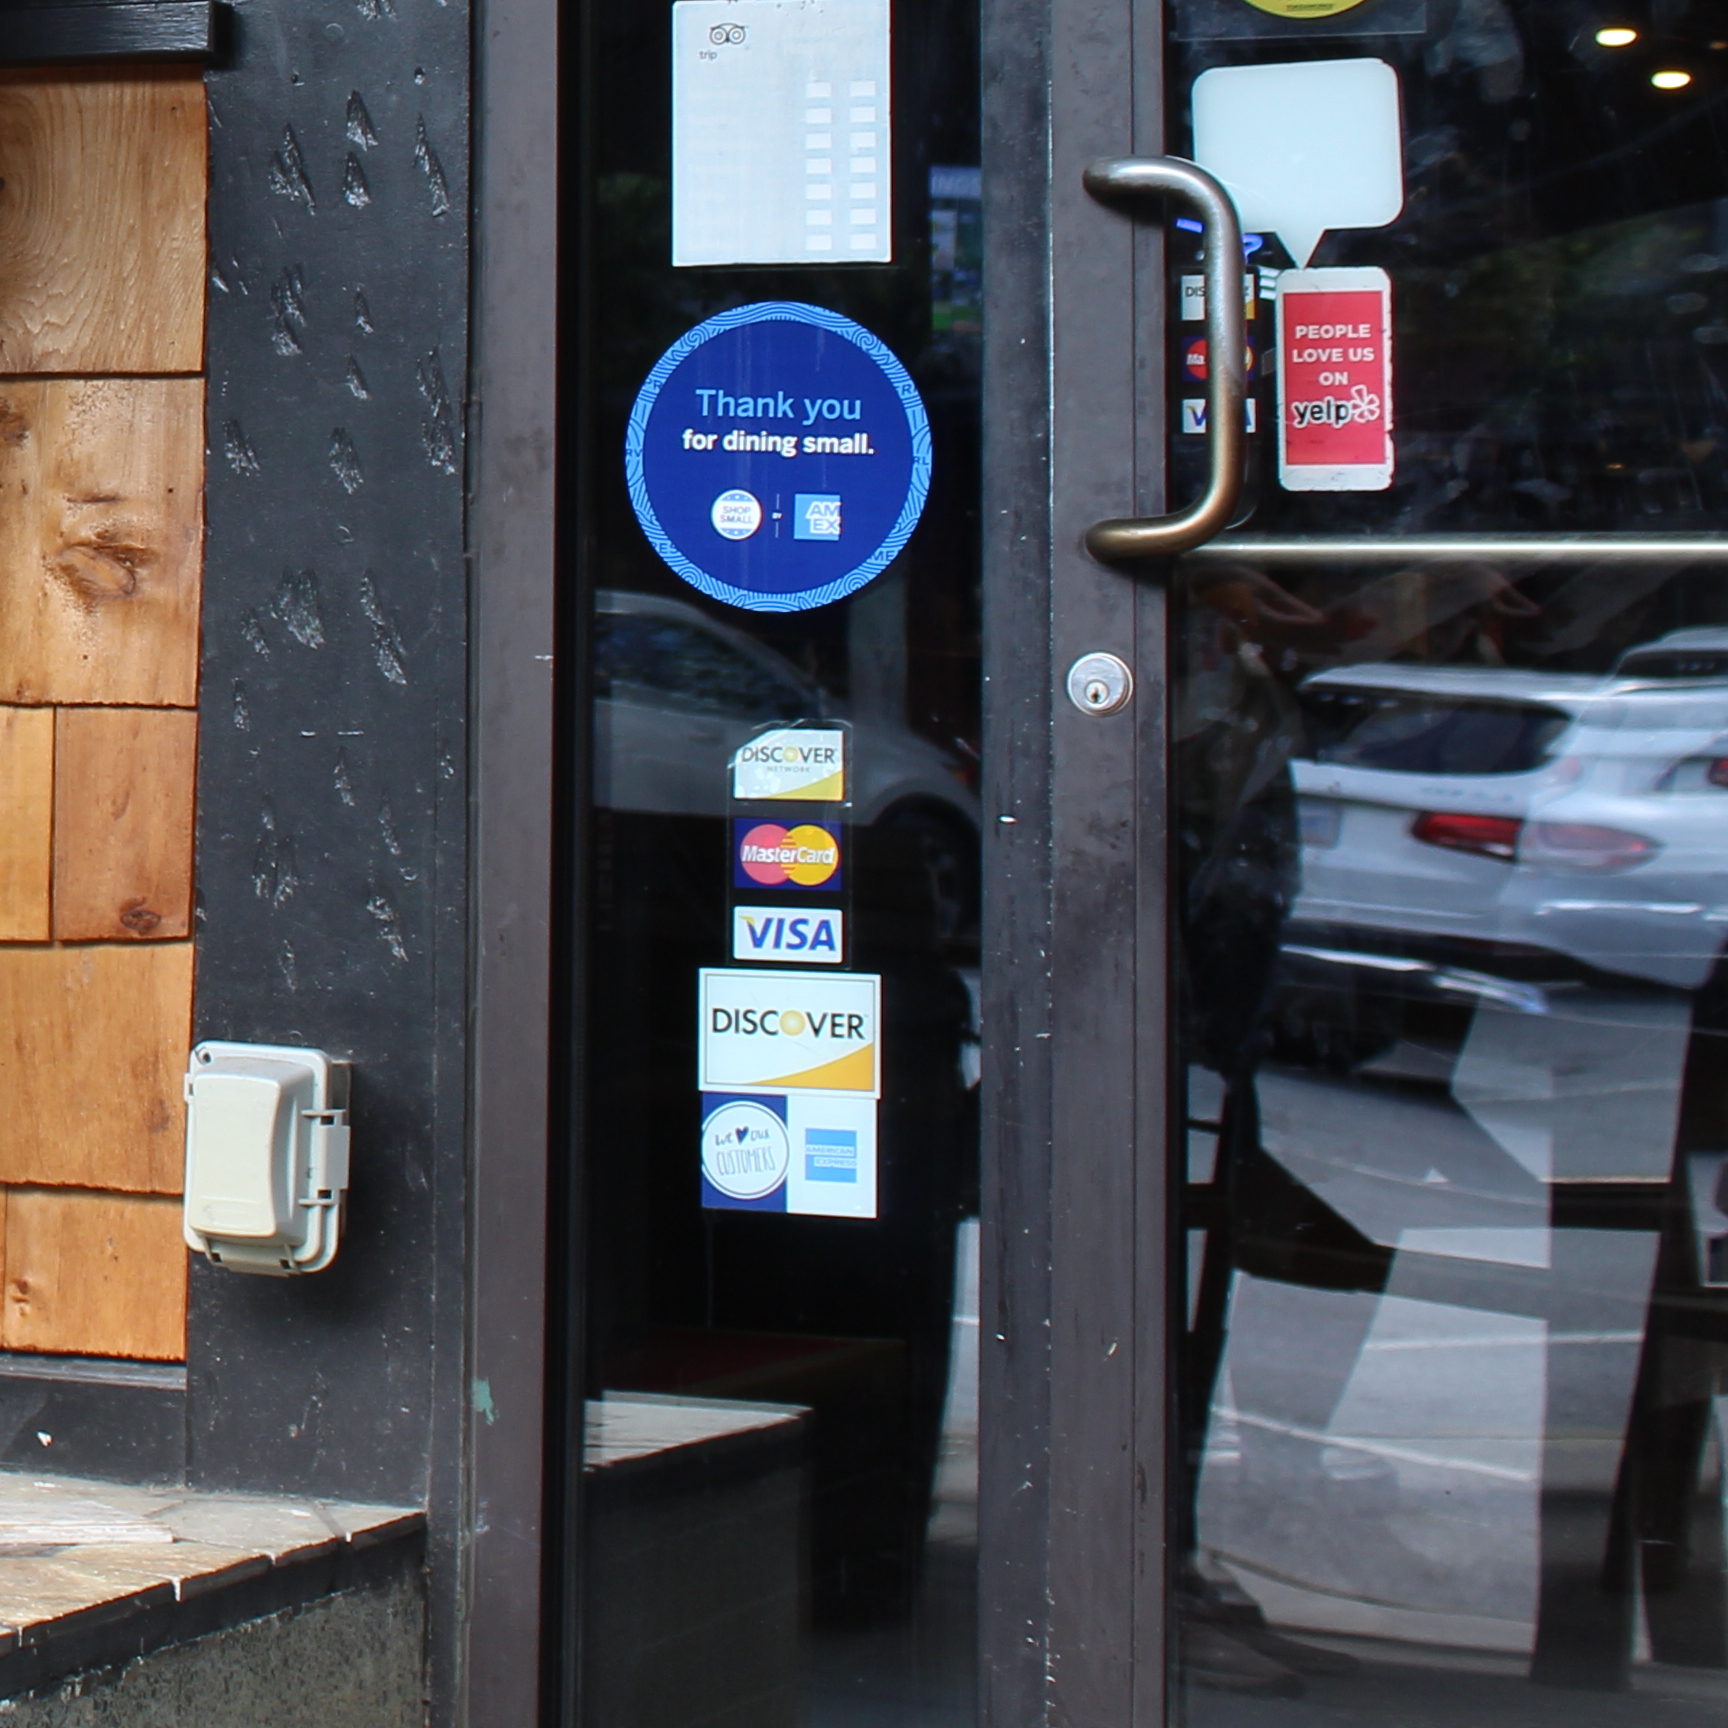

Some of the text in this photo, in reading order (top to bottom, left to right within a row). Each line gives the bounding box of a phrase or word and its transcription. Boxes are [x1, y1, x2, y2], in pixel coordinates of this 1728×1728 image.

[1294, 323, 1372, 339] PEOPLE
[1292, 347, 1375, 363] LOVE US
[1318, 371, 1349, 386] ON
[695, 388, 862, 426] Thank you
[1293, 397, 1352, 428] yelp
[682, 428, 876, 458] for dining small.
[722, 505, 752, 515] SHOP
[807, 501, 841, 518] AM
[719, 514, 754, 525] SMALL
[810, 517, 841, 534] EX
[741, 745, 836, 764] DISCOVER
[766, 765, 811, 773] NETWORK
[741, 844, 836, 865] MasterCard
[738, 915, 838, 952] VISA
[711, 1007, 866, 1040] DISCOVER
[806, 1145, 854, 1156] AMERICAN
[716, 1146, 777, 1176] CUSTOMERS
[815, 1157, 858, 1168] EXPRESS
